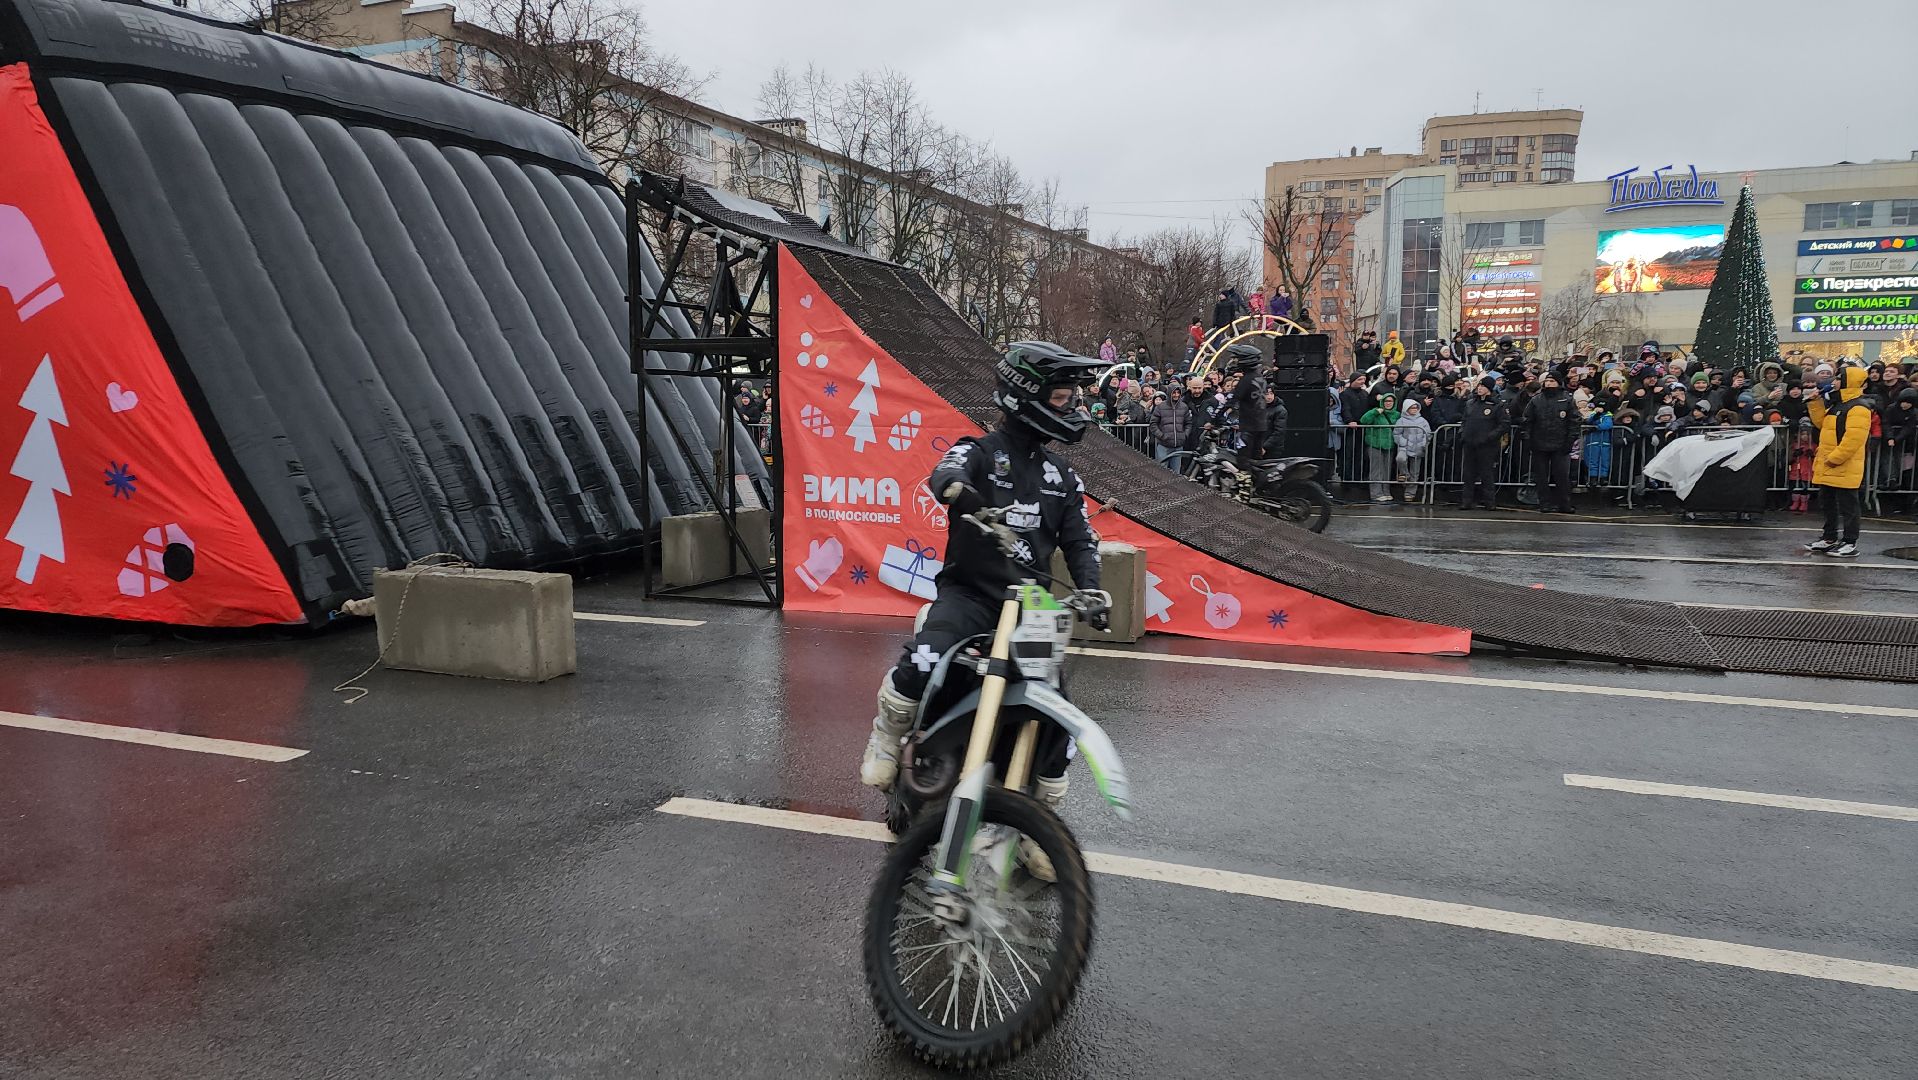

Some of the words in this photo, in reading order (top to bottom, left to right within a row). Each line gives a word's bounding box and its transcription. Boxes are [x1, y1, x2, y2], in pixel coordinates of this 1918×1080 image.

[1809, 241, 1853, 250] Детский
[1854, 240, 1876, 250] мир
[1466, 289, 1496, 299] DNS
[1815, 297, 1912, 309] СУПЕРМАРКЕТ
[803, 473, 901, 507] ЗИМА
[814, 509, 901, 524] ПОДМОСКОВЬЕ
